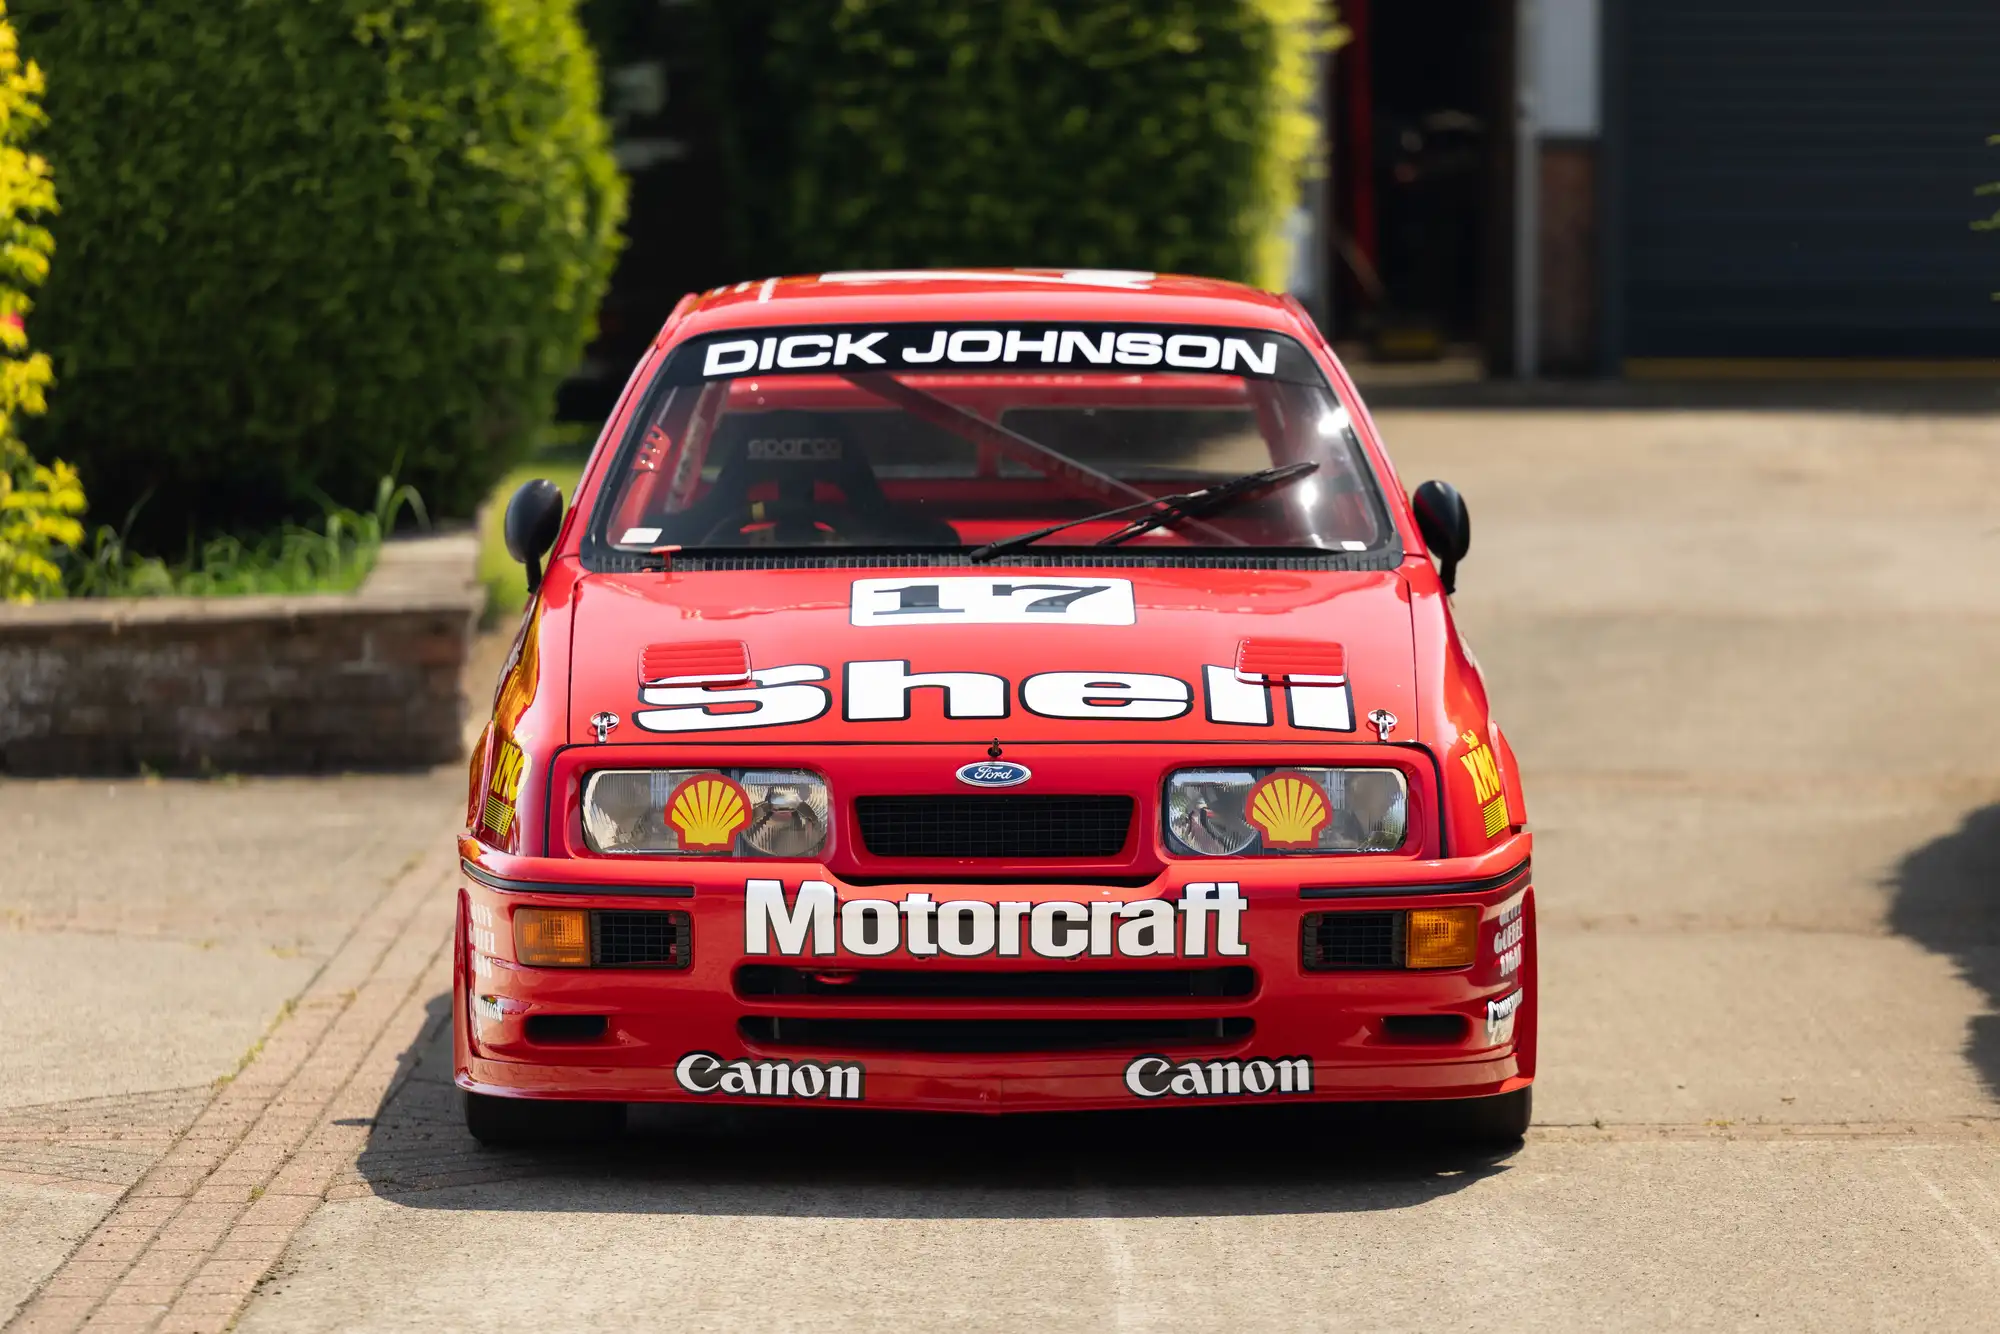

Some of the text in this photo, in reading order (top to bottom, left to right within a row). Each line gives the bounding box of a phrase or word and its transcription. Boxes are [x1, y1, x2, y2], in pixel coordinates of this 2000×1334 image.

[703, 329, 1279, 377] DICK JOHNSON
[872, 583, 1112, 617] 17
[632, 659, 1356, 733] Shell
[974, 766, 1013, 780] Ford
[744, 878, 1249, 958] Motorcraft
[675, 1053, 861, 1099] Canon
[1125, 1056, 1312, 1097] Canon
